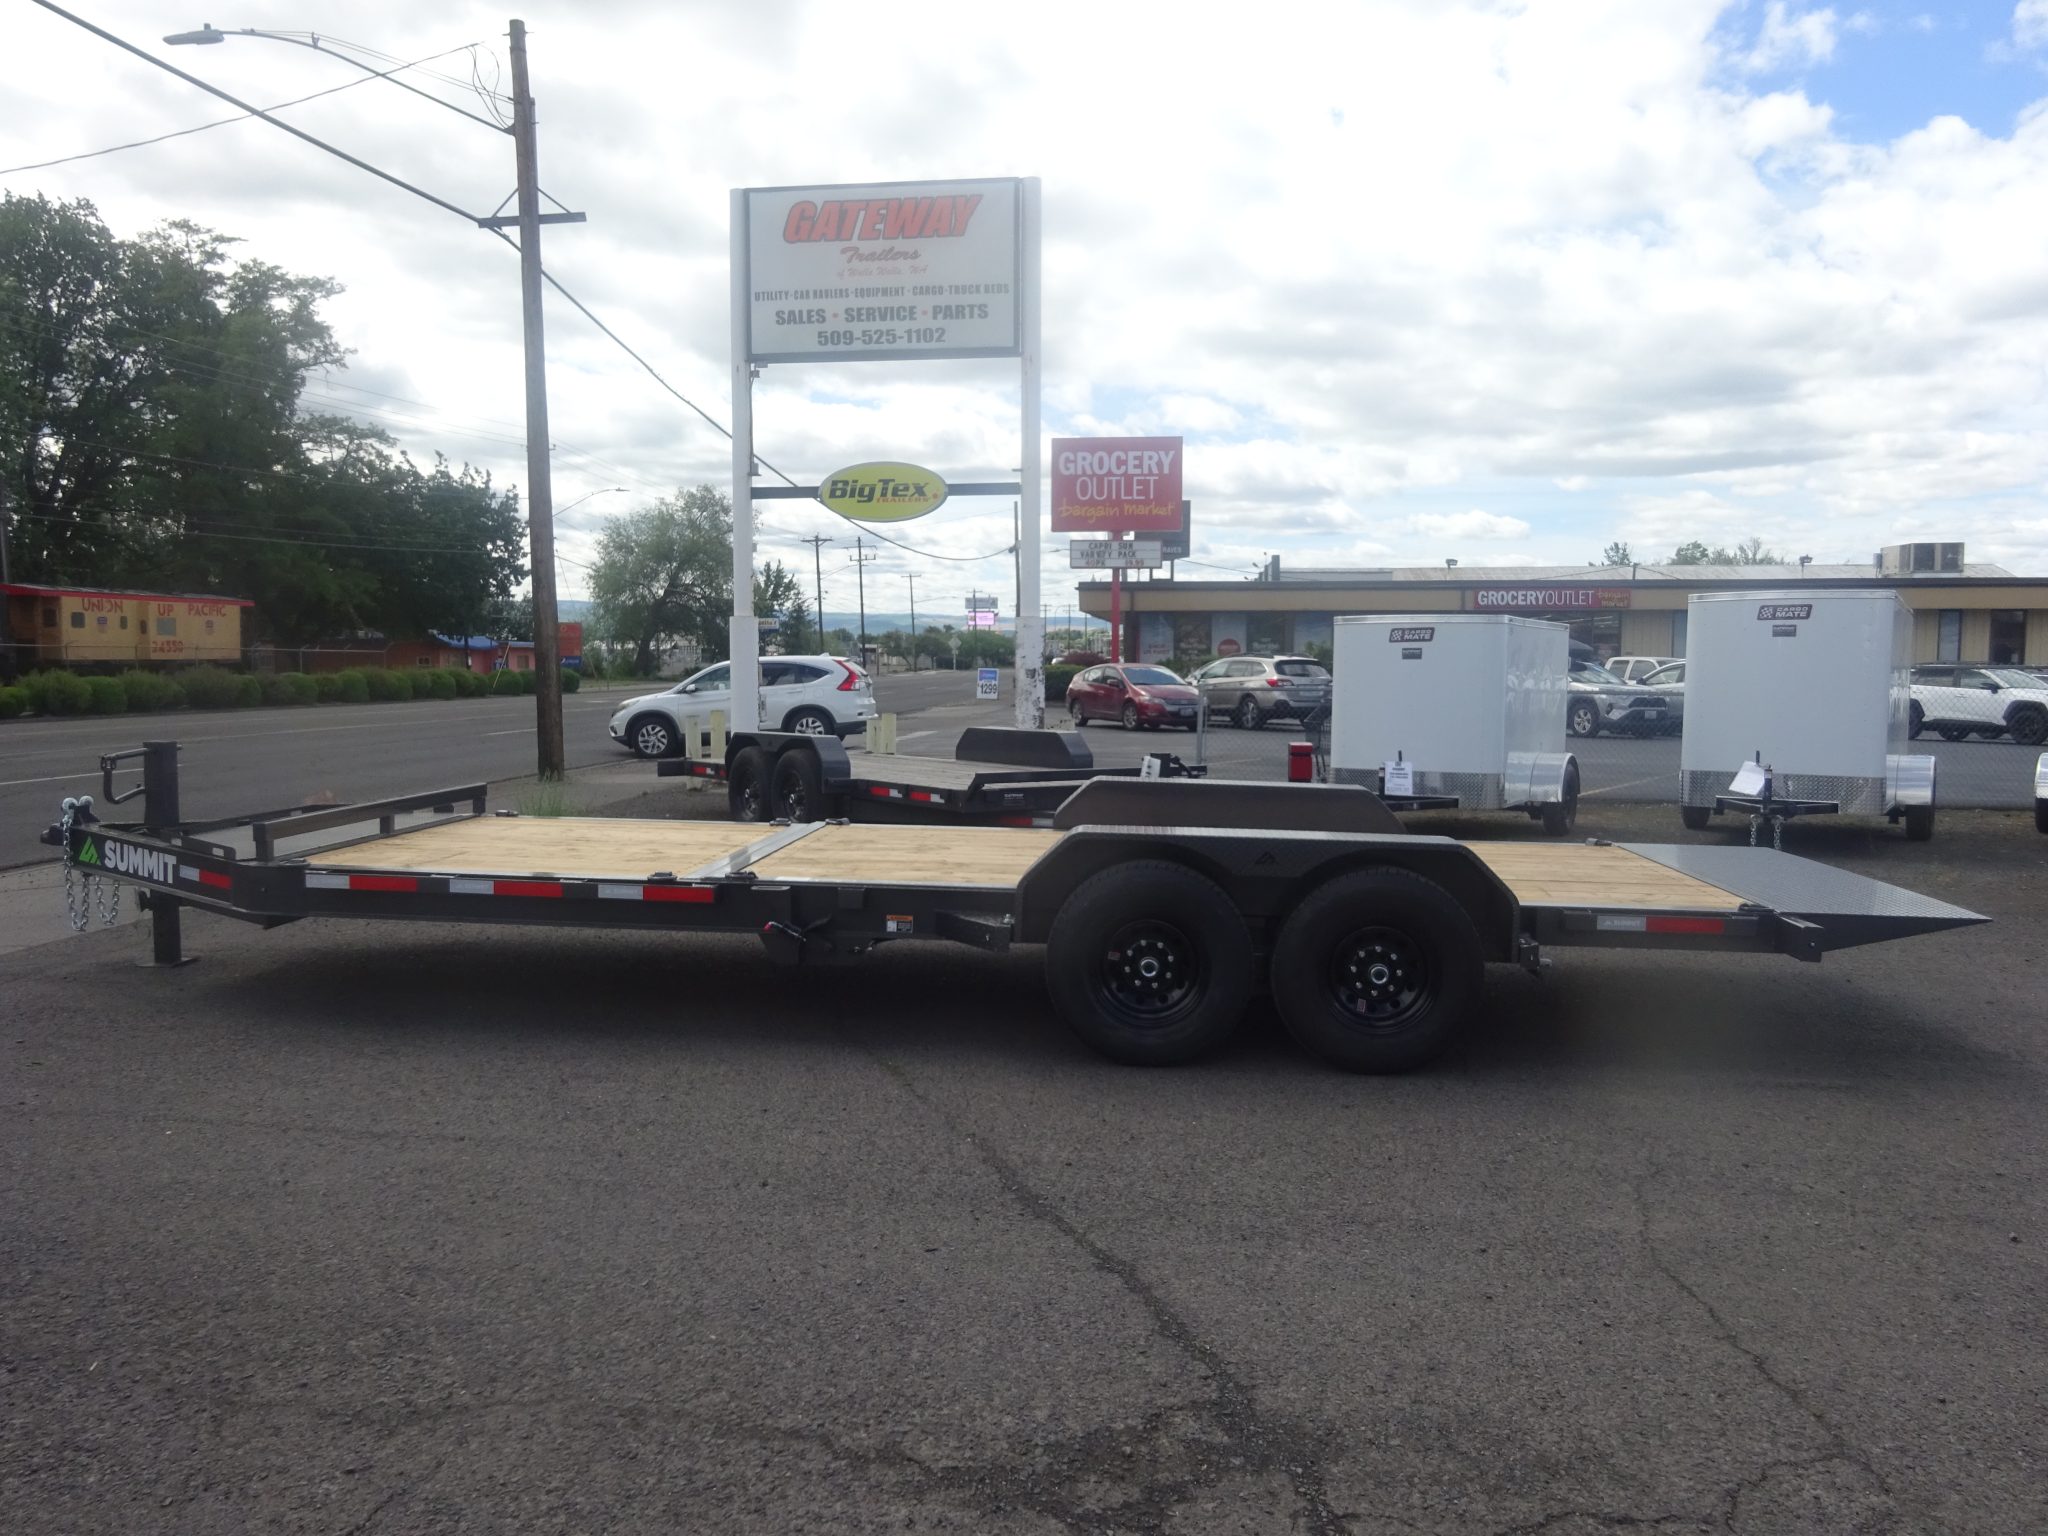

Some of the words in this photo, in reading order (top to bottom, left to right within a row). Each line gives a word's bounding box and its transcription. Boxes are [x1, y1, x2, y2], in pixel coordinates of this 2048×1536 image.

[783, 194, 983, 244] GATEWAY
[840, 246, 922, 264] Trailers
[754, 290, 790, 302] UTILITY
[793, 289, 811, 300] CAR
[812, 288, 850, 300] HAULERS
[854, 286, 905, 299] EQUIPMENT
[912, 285, 944, 297] CARGO
[948, 284, 982, 296] TRUCK
[775, 308, 827, 326] SALES
[844, 305, 917, 323] SERVICE
[932, 303, 989, 321] PARTS
[817, 327, 947, 346] 509-525-1102
[1059, 450, 1175, 475] GROCERY
[1076, 476, 1159, 500] OUTLET
[1059, 498, 1119, 523] bargain
[1124, 502, 1176, 516] market
[1118, 550, 1136, 558] PACK
[82, 598, 123, 613] UNION
[157, 603, 175, 616] UP
[188, 603, 226, 617] PACIFIC
[104, 839, 177, 884] SUMMIT
